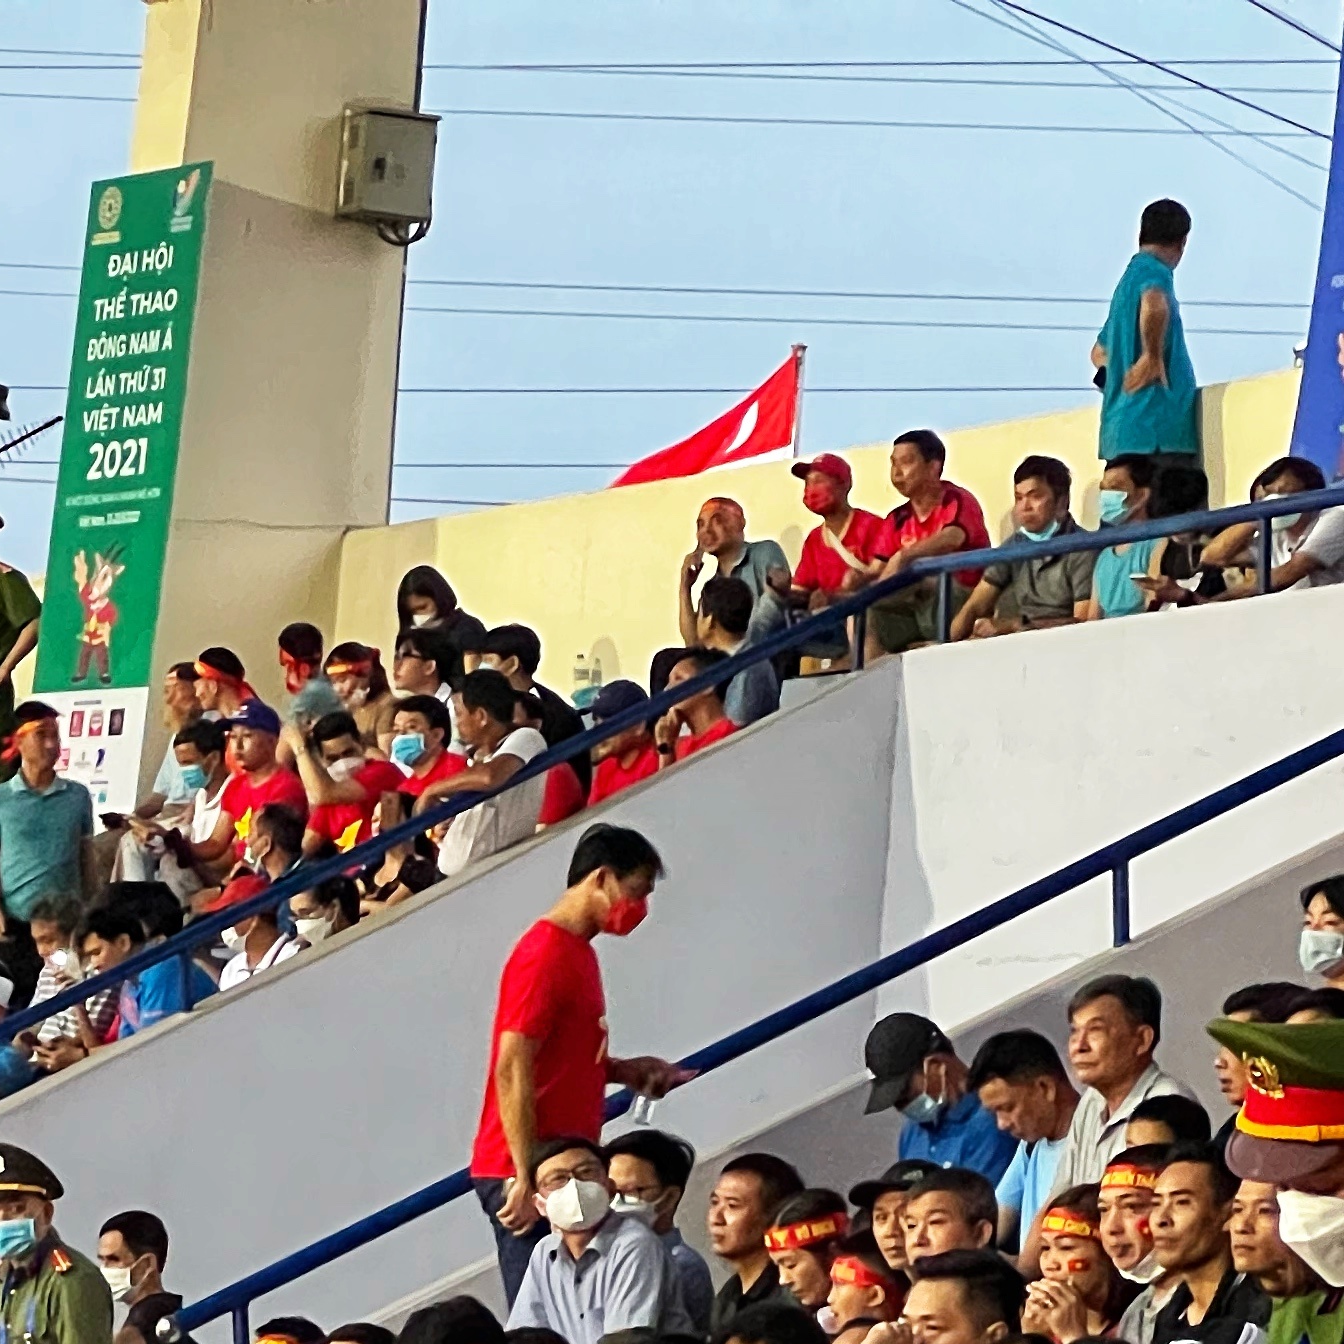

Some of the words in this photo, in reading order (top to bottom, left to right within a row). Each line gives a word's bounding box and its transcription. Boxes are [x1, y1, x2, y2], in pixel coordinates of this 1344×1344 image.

[108, 251, 138, 281] ĐẠI
[142, 241, 174, 276] HỘI
[130, 288, 178, 317] THAO
[87, 331, 126, 362] ĐÔNG
[130, 330, 159, 355] NAM
[161, 320, 173, 352] Á
[151, 367, 167, 390] 31
[83, 403, 120, 437] VIỆT
[123, 402, 163, 428] NAM
[86, 438, 148, 480] 2021
